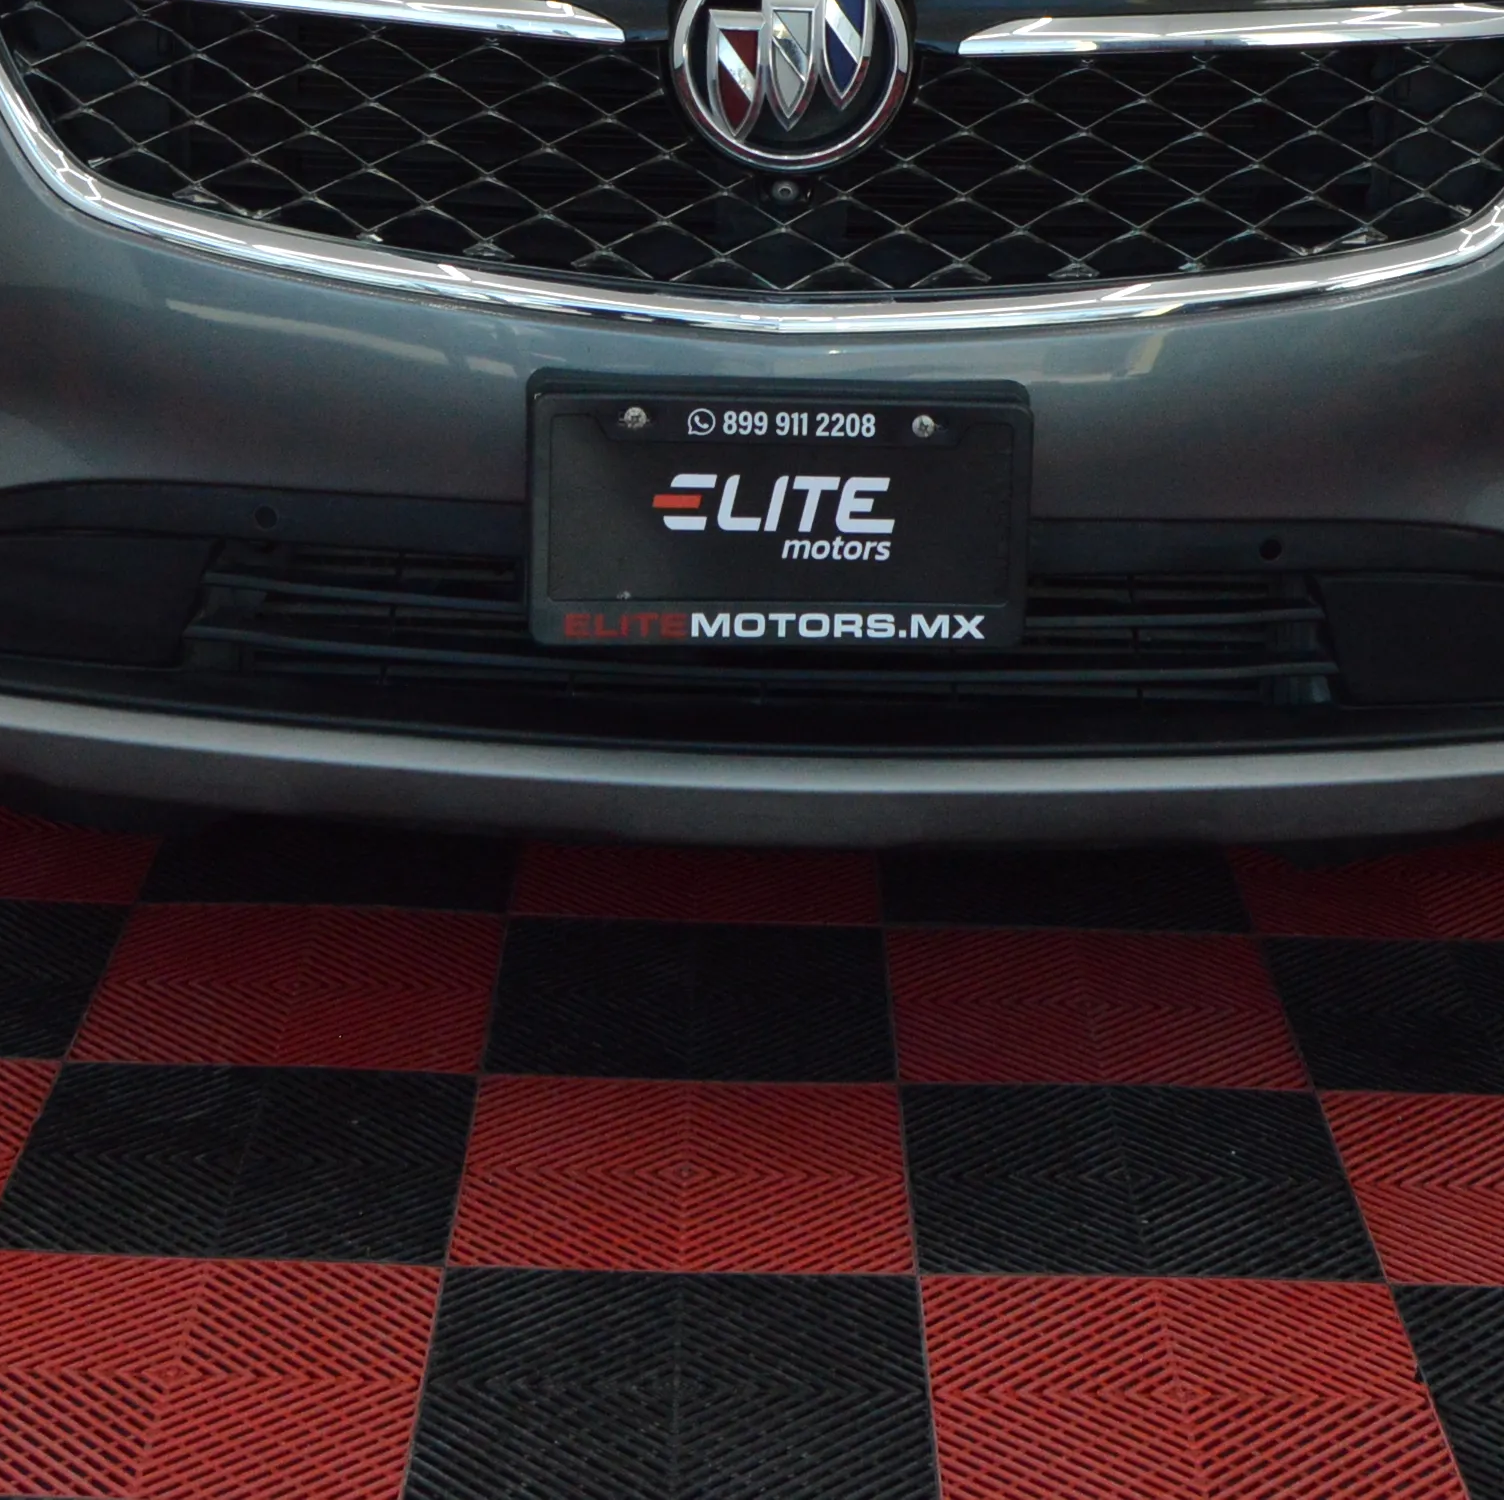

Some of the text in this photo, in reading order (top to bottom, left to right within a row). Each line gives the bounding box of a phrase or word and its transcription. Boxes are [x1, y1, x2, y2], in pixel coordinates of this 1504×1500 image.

[722, 410, 877, 438] 899 911 2208
[652, 473, 896, 534] ELITE
[781, 536, 892, 562] motors
[563, 611, 986, 641] ELITEMOTORS.MX
